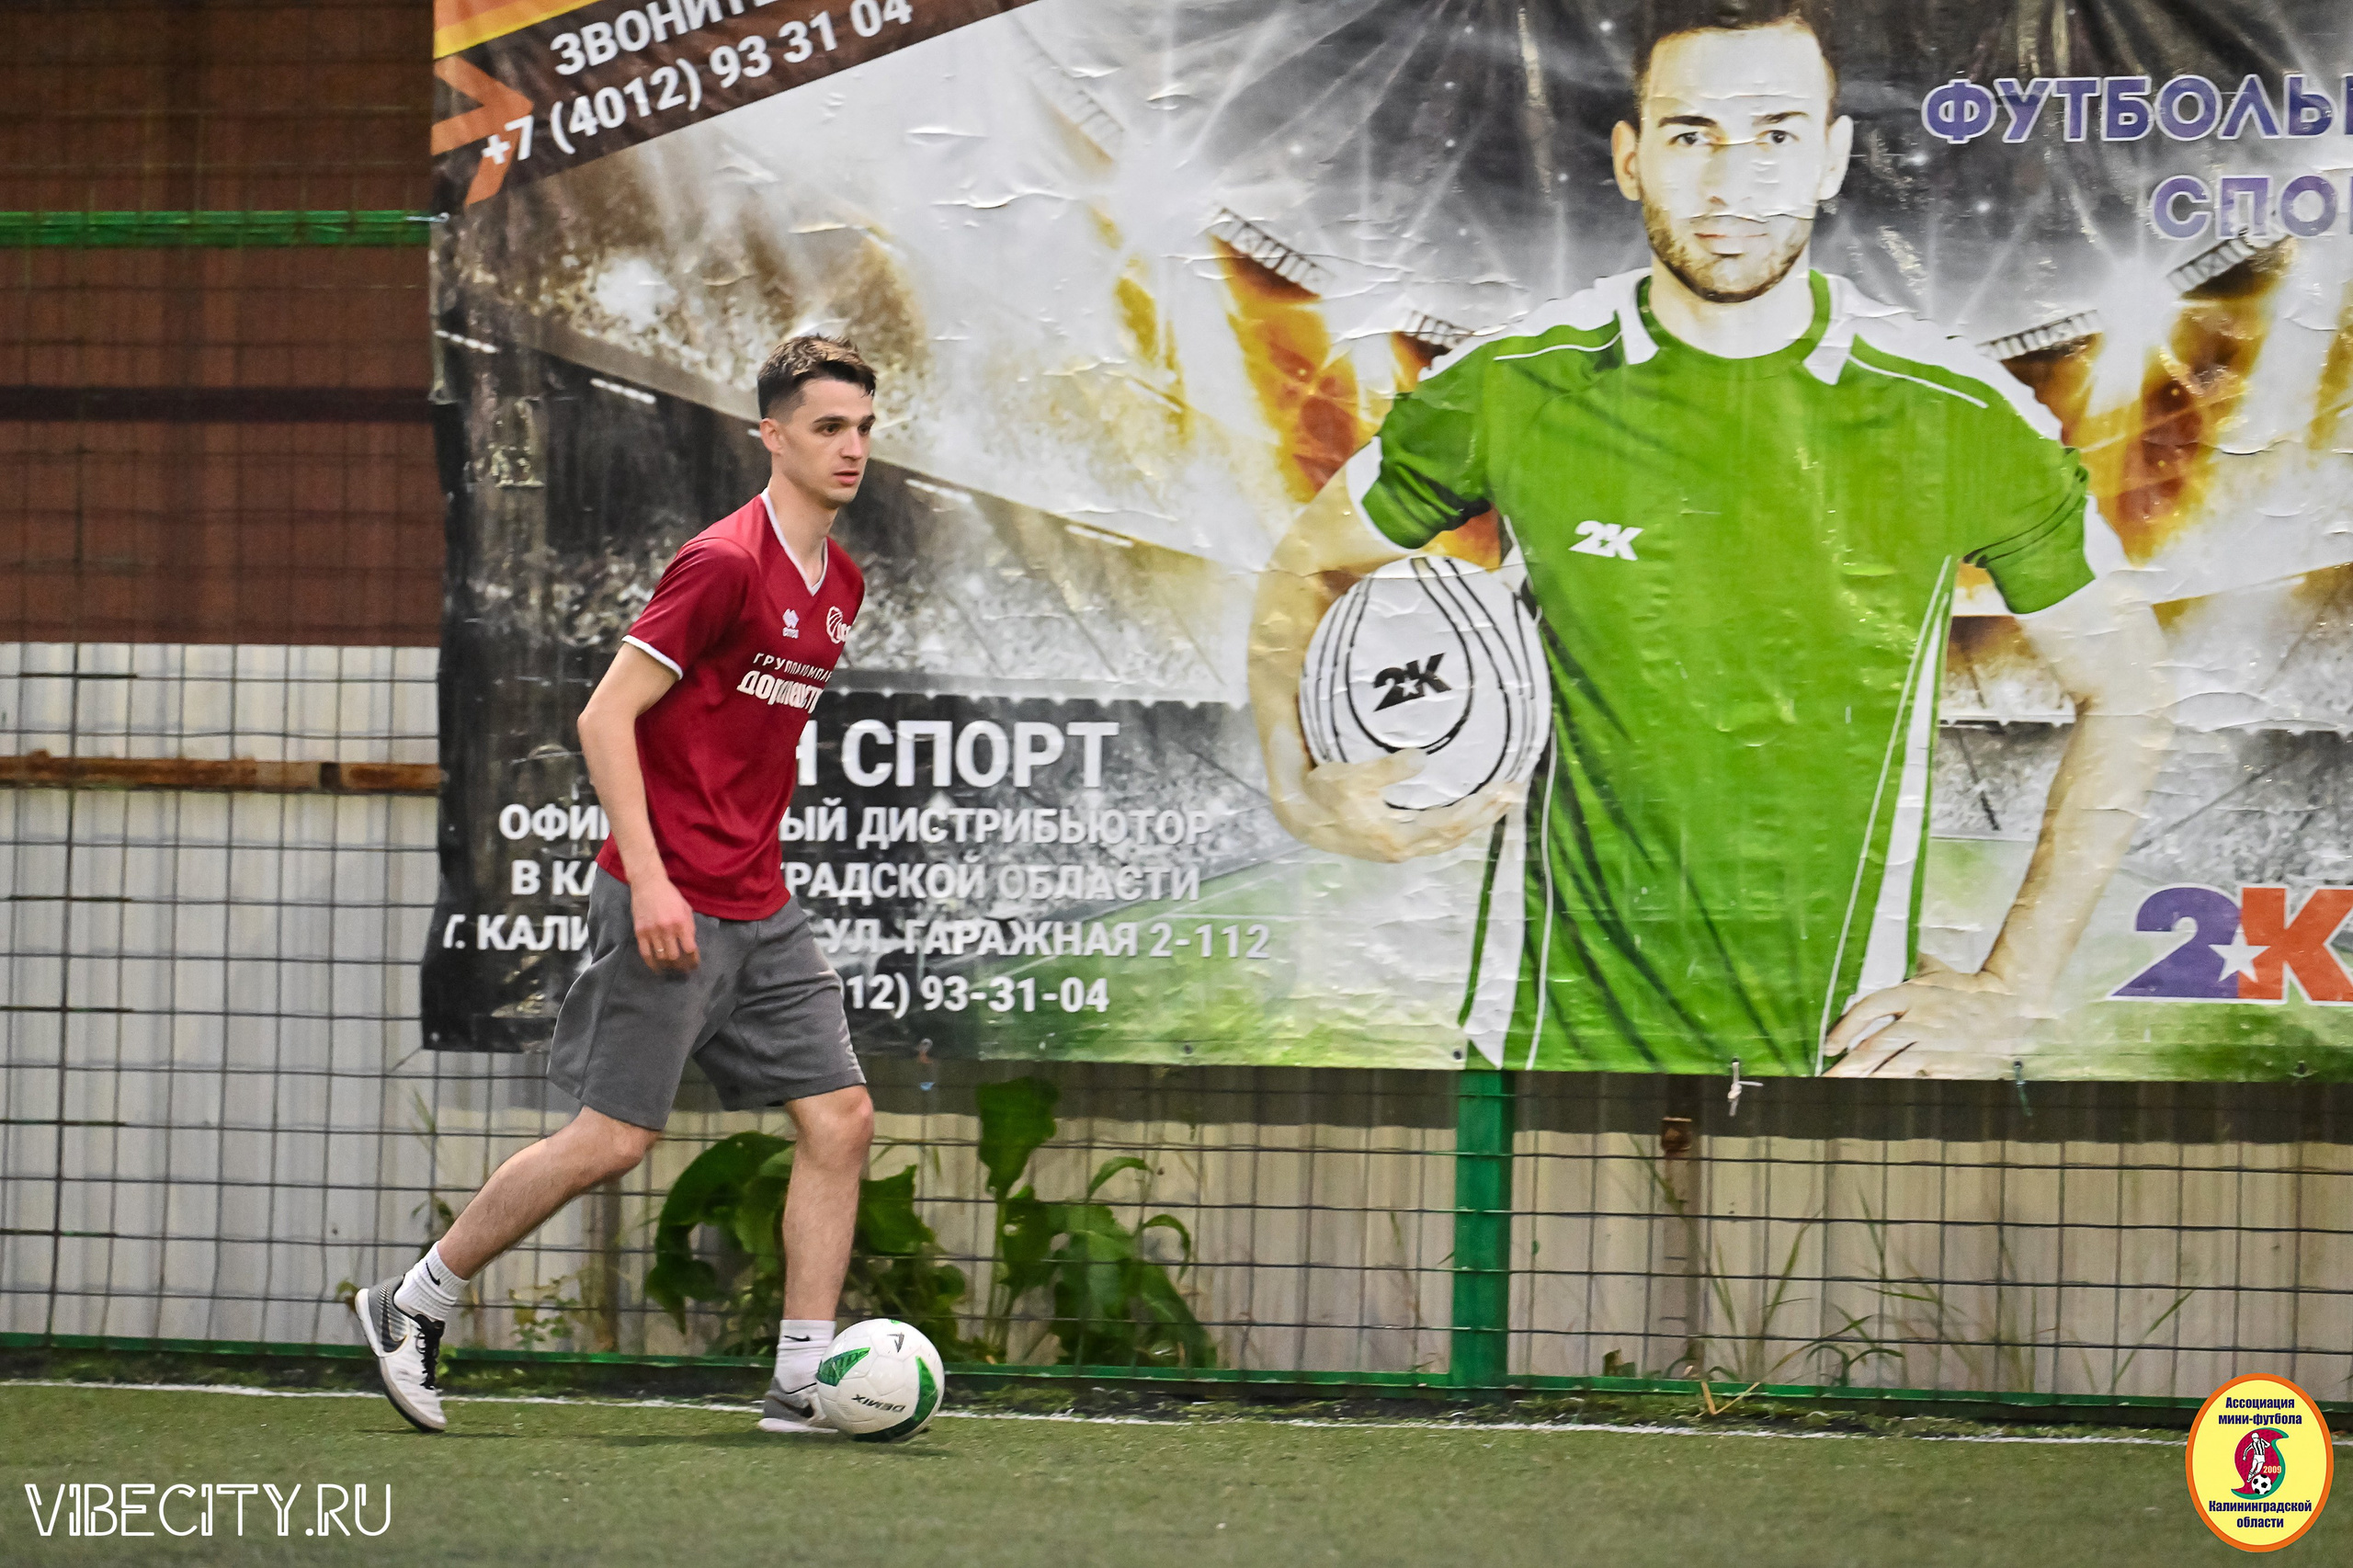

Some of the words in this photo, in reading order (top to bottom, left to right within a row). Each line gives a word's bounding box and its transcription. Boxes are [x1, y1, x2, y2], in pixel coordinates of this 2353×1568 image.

[551, 0, 781, 75] ЗВОНИ
[481, 114, 535, 165] +7
[550, 58, 702, 154] (4012)
[710, 35, 773, 89] 93
[778, 10, 838, 63] 31
[849, 0, 914, 38] 04
[1922, 73, 2353, 143] ФУТБОЛЬ
[2151, 175, 2353, 241] СПО
[841, 718, 1120, 789] СПОРТ
[857, 806, 1211, 850] ДИСТРИБЬЮТОР
[510, 859, 541, 895] В
[780, 849, 988, 906] РАДСКОЙ
[997, 862, 1200, 902] ОБЛАСТИ
[442, 914, 466, 949] Г.
[904, 919, 1139, 957] ГАРАЖНАЯ
[1149, 922, 1271, 959] 2-112
[920, 974, 1110, 1013] 93-31-04
[851, 1393, 906, 1415] DEMIX
